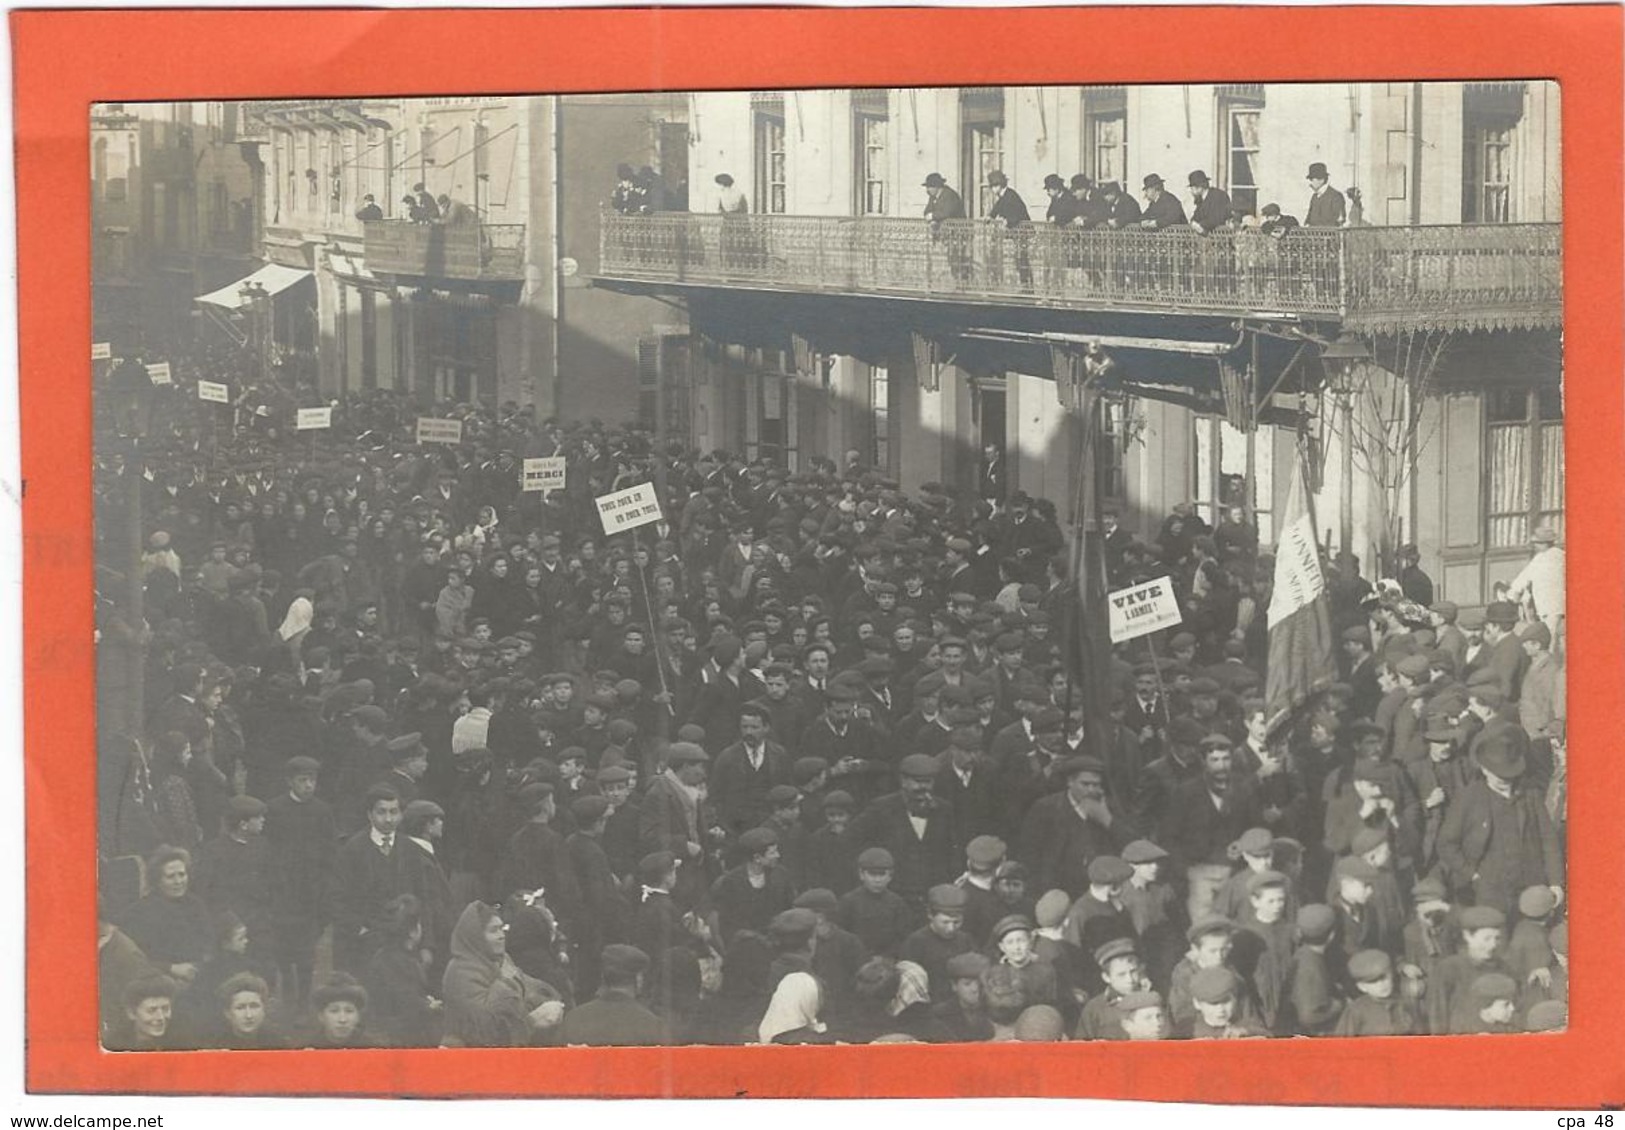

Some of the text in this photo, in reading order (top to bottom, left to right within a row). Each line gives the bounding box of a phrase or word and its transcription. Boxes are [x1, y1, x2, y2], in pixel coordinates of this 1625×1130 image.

[526, 470, 563, 479] MERCI
[600, 501, 616, 512] TOUS
[617, 496, 632, 507] POUR
[615, 514, 624, 523] UN
[625, 509, 641, 520] POUR
[1112, 585, 1163, 608] VIVE
